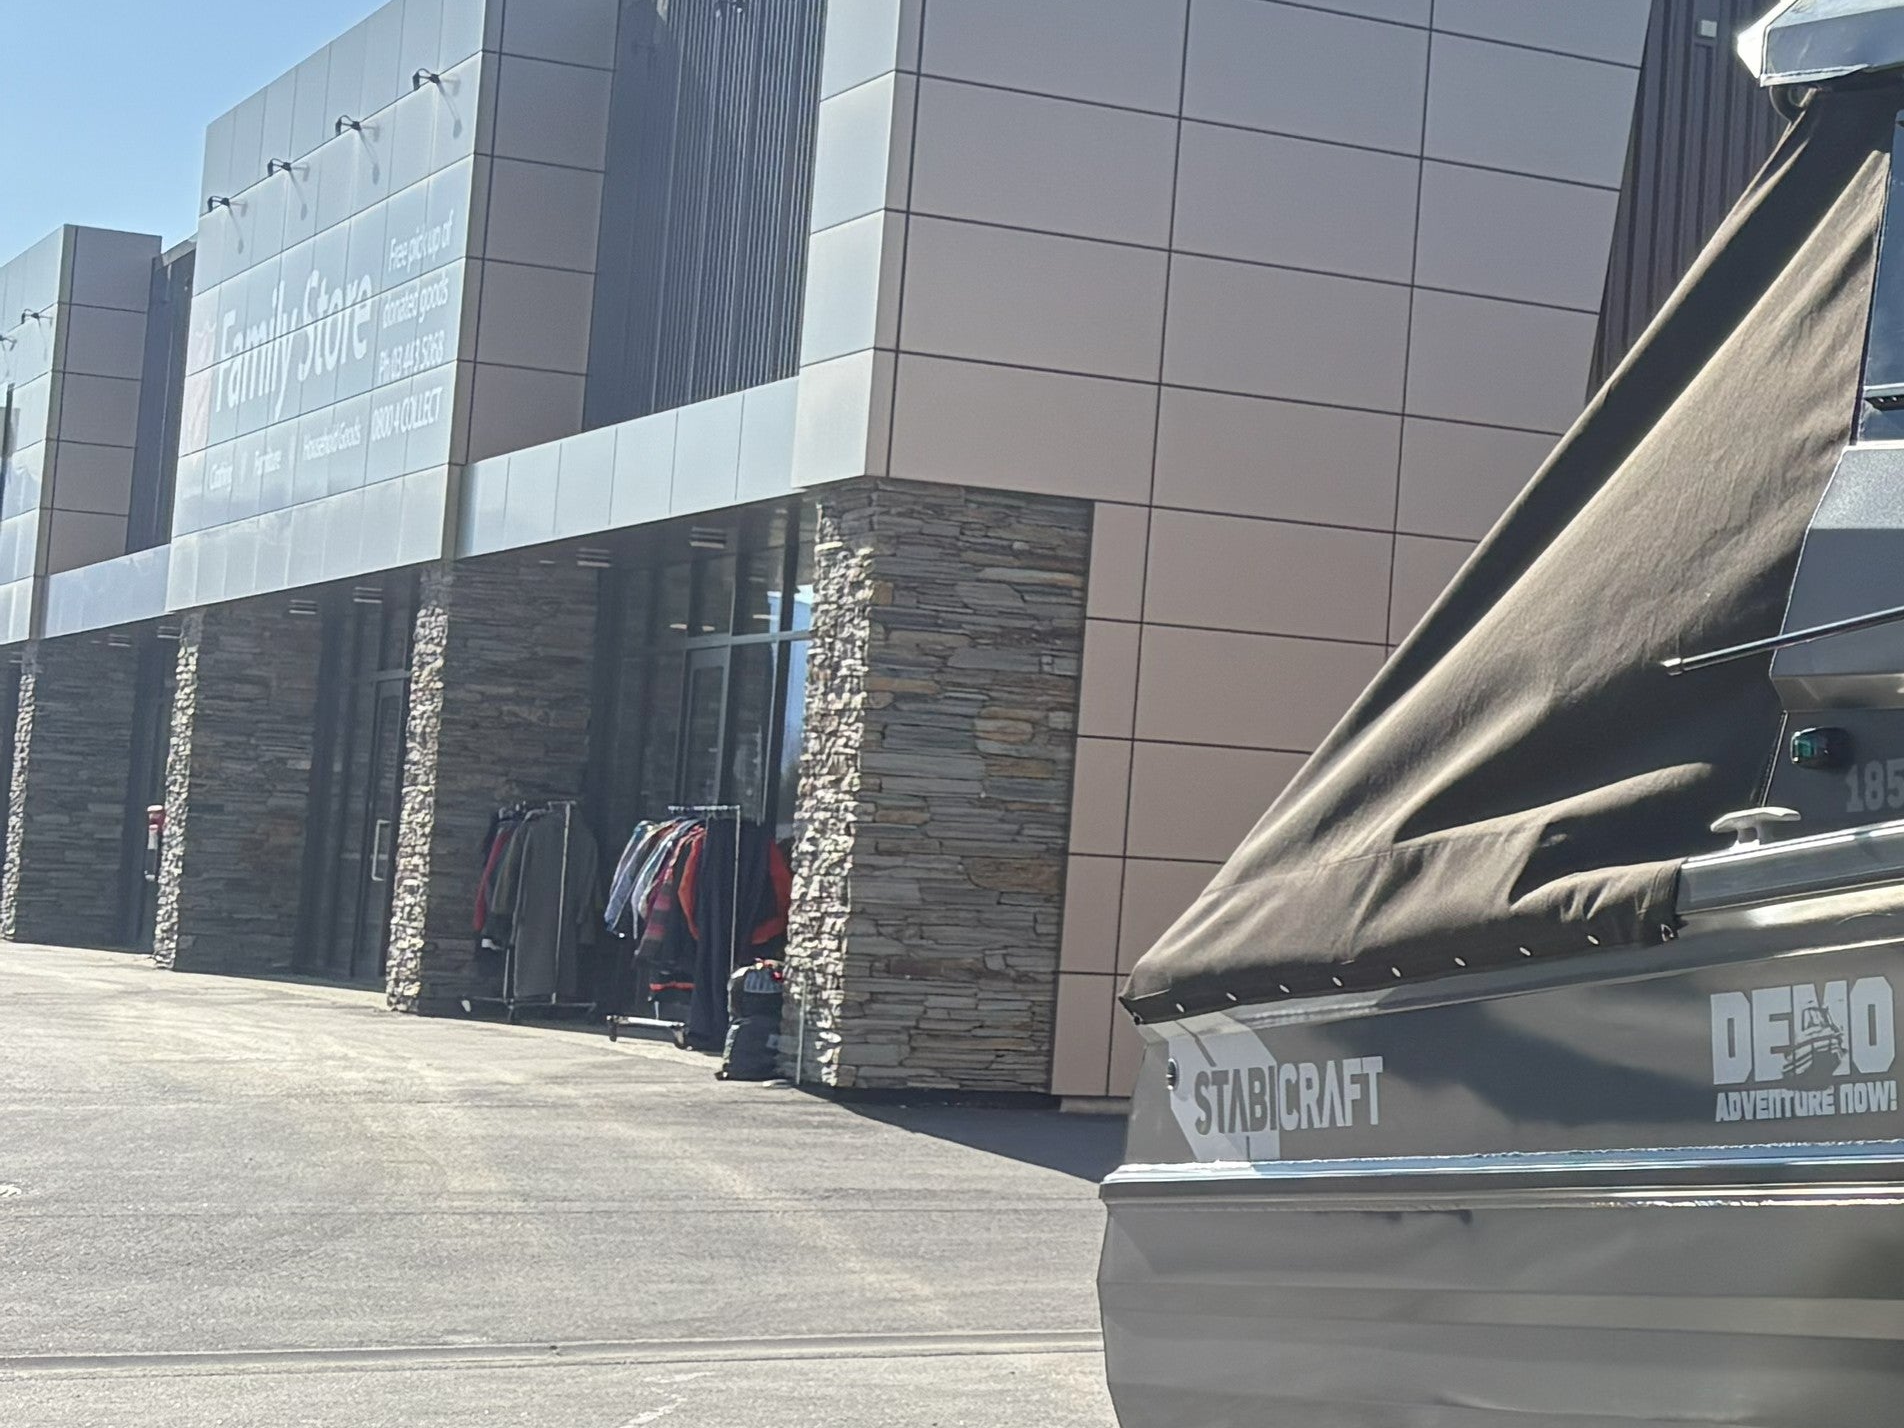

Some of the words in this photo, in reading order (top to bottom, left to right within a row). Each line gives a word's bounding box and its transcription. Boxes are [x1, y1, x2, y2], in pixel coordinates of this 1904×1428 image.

[388, 237, 408, 272] Free
[383, 281, 420, 329] donated
[419, 268, 449, 324] goods
[216, 279, 298, 422] Family
[297, 269, 373, 383] Store
[372, 405, 394, 441] 0800
[400, 387, 443, 433] COLLECT
[1710, 976, 1895, 1085] DEMO
[1195, 1056, 1383, 1136] STABICRAFT
[1715, 1086, 1836, 1122] ADVENTURE
[1839, 1080, 1898, 1114] NOW!
